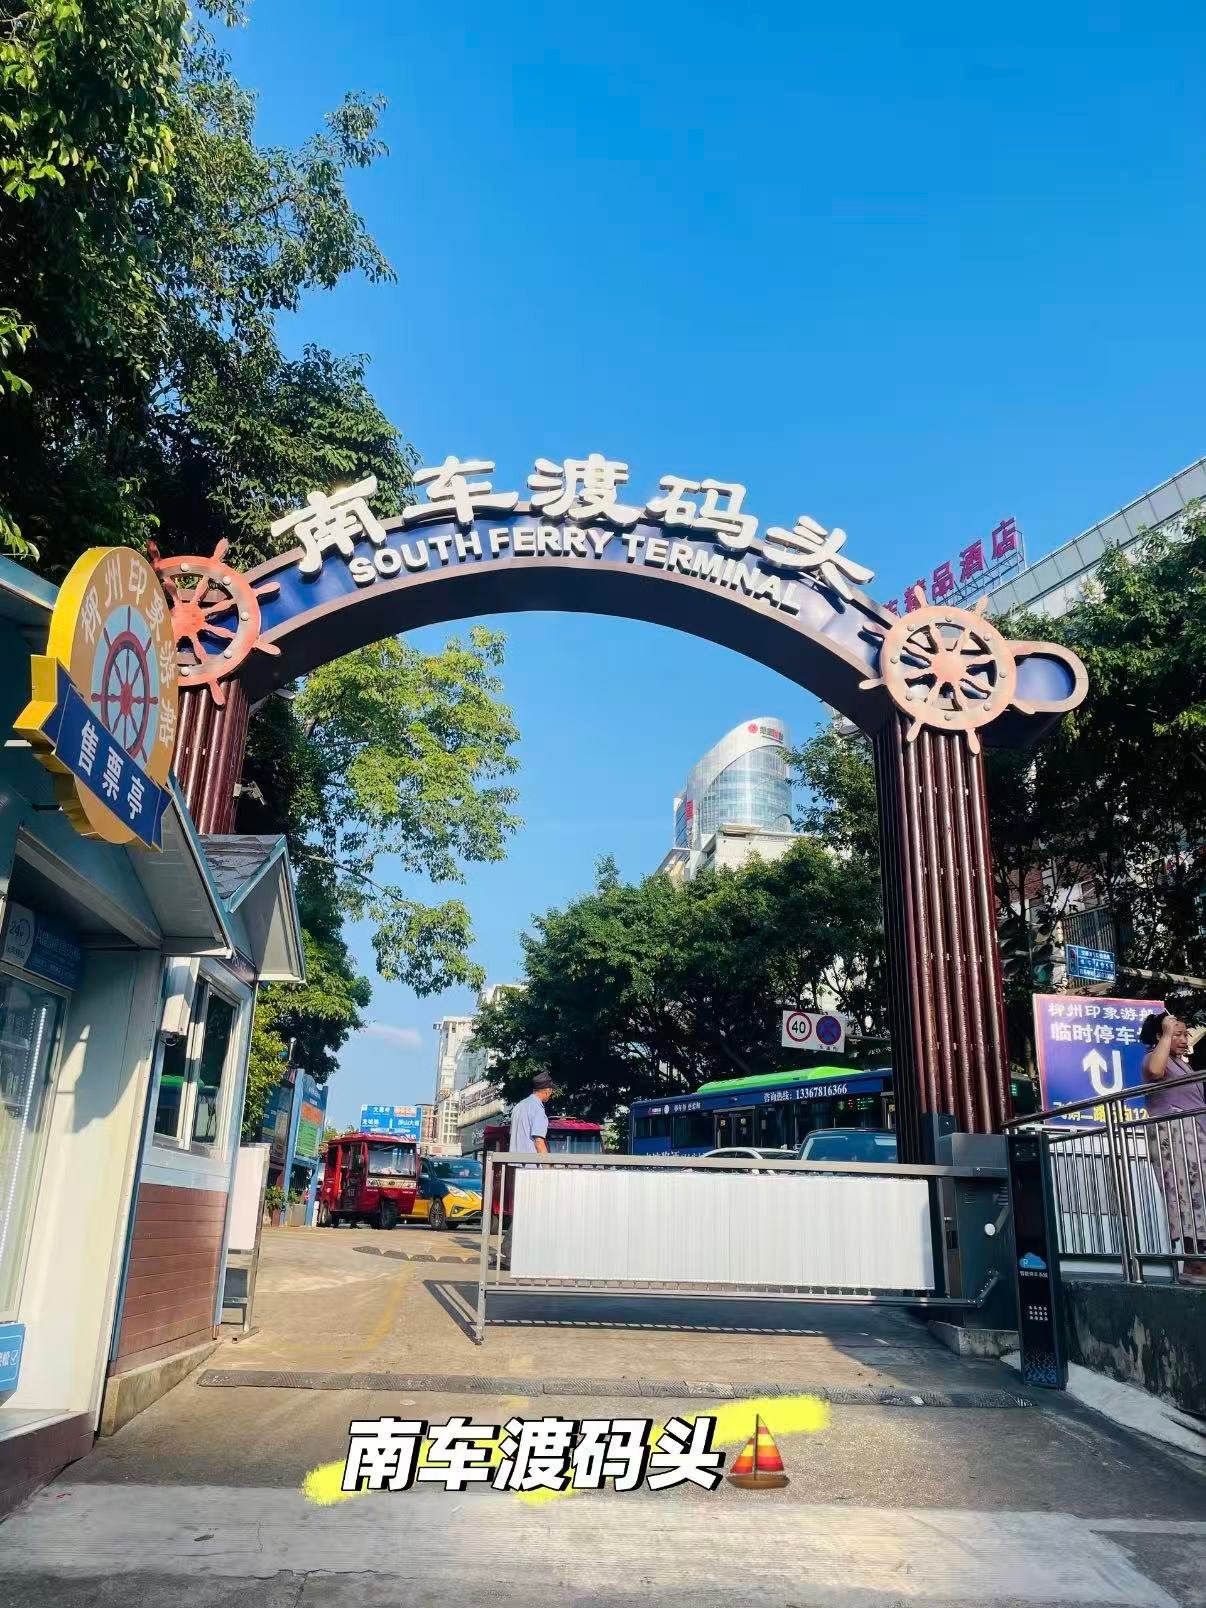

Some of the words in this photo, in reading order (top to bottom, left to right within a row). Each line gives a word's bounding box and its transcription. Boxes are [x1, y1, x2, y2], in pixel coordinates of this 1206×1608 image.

[271, 453, 875, 599] 南车渡码头
[351, 530, 483, 585] SOUTH
[490, 525, 615, 558] FERRY
[622, 533, 801, 613] TERMINAL
[78, 720, 146, 820] 售票亭
[791, 1020, 806, 1034] 40
[1050, 1021, 1144, 1046] 临时停车
[796, 1083, 848, 1100] 13367816366
